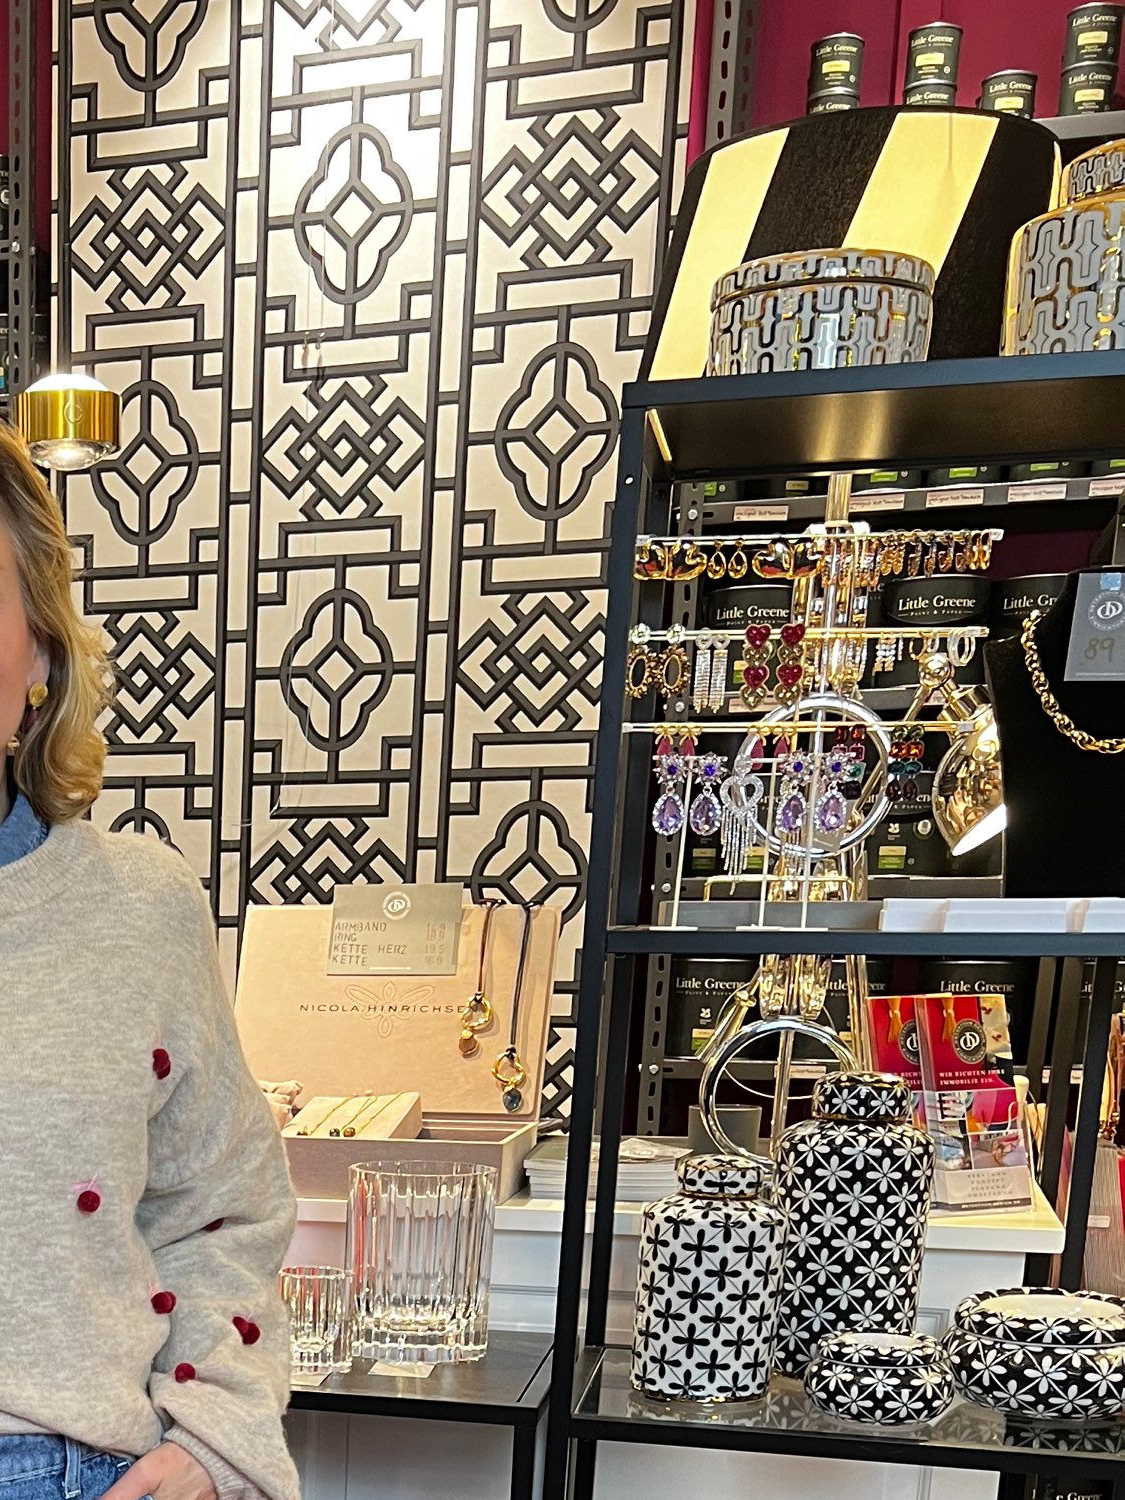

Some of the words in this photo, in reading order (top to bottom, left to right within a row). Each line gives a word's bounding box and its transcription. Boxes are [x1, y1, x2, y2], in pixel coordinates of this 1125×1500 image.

[898, 597, 929, 611] Little
[932, 595, 976, 608] Greene
[1004, 596, 1034, 611] Little
[717, 608, 743, 620] Little
[747, 605, 789, 618] Greene
[335, 923, 387, 932] ARMBAND
[333, 943, 368, 954] KETTE
[378, 944, 408, 954] HERZ
[332, 955, 368, 966] KETTE
[676, 978, 702, 988] Little
[940, 980, 971, 992] Little
[975, 980, 1015, 992] Greene
[300, 1004, 360, 1012] NICOLA
